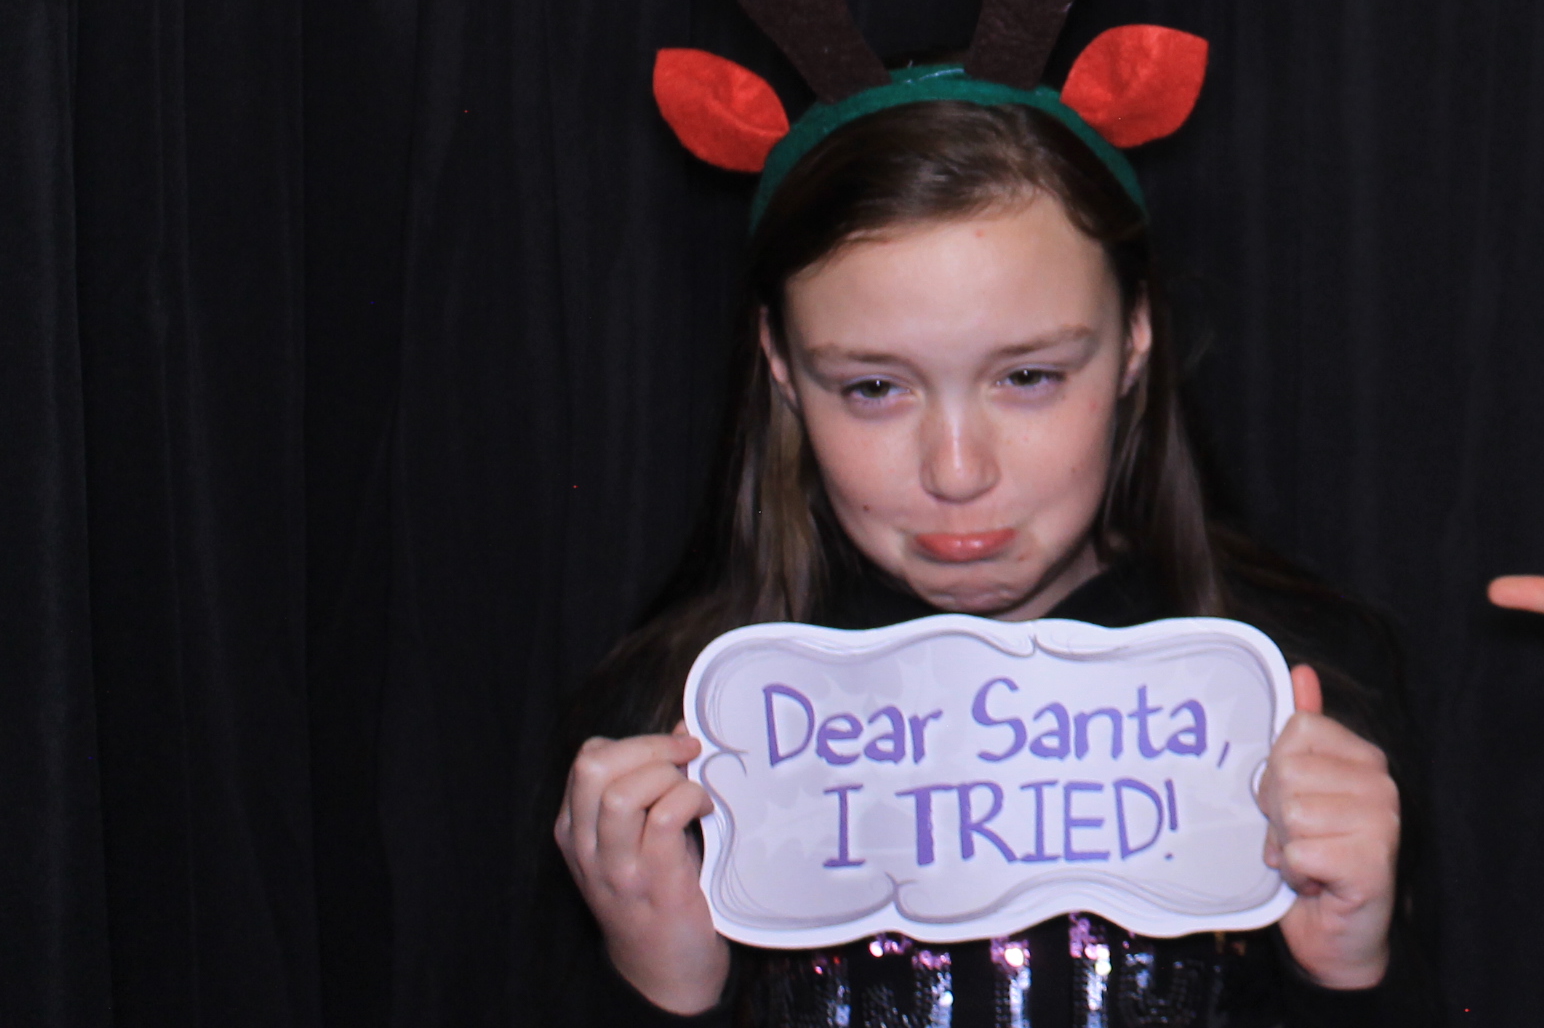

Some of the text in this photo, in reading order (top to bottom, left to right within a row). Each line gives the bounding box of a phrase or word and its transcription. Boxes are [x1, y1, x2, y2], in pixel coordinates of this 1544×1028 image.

[763, 677, 1230, 768] Dear Santa,
[823, 779, 1178, 868] I TRIED!
